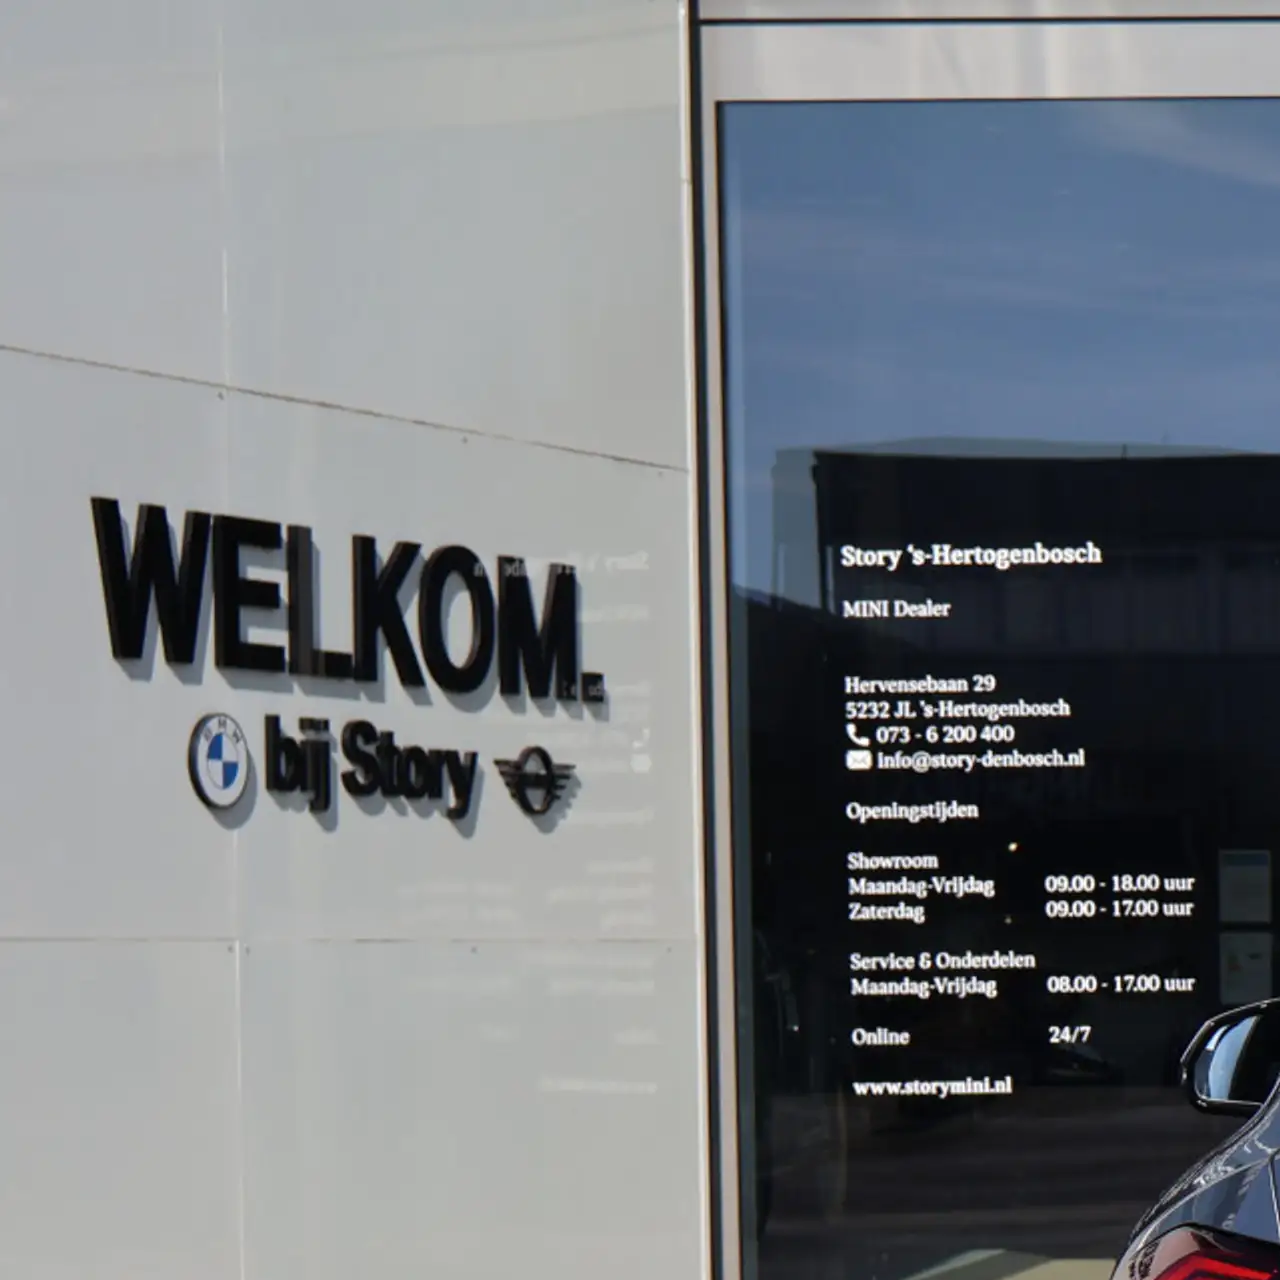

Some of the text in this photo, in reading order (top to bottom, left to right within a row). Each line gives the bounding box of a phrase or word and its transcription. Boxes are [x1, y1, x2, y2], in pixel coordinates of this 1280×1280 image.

[840, 544, 902, 571] Story
[90, 497, 605, 703] WELKOM.
[842, 598, 952, 618] MINI Dealer
[844, 674, 996, 694] Hervensebaan 29
[845, 698, 1071, 721] 5232 JL 's-Hertogenbosch
[875, 725, 911, 744] 073
[925, 725, 939, 744] 6
[942, 724, 978, 743] 200
[980, 724, 1016, 743] 400
[264, 714, 479, 820] bij Story
[877, 748, 1086, 773] info@story-denbosch.nl
[845, 801, 979, 824] Openingstijden
[847, 851, 939, 870] Showroom
[848, 876, 996, 899] Maandag-Vrijdag
[1044, 874, 1096, 893] 09.00
[1112, 873, 1161, 892] 18.00
[1163, 877, 1196, 891] uur
[848, 902, 926, 924] Zaterdag
[1045, 899, 1097, 918] 09.00
[1112, 899, 1160, 917] 17.00
[1162, 902, 1195, 916] uur
[849, 950, 1036, 971] Service & Onderdelen
[851, 976, 998, 999] Maandag-Vrijdag
[1046, 975, 1098, 994] 08.00
[1114, 974, 1161, 993] 17.00
[1164, 978, 1196, 992] uur
[851, 1025, 1092, 1046] Online 24/7
[852, 1077, 1013, 1099] www.storymini.nl
